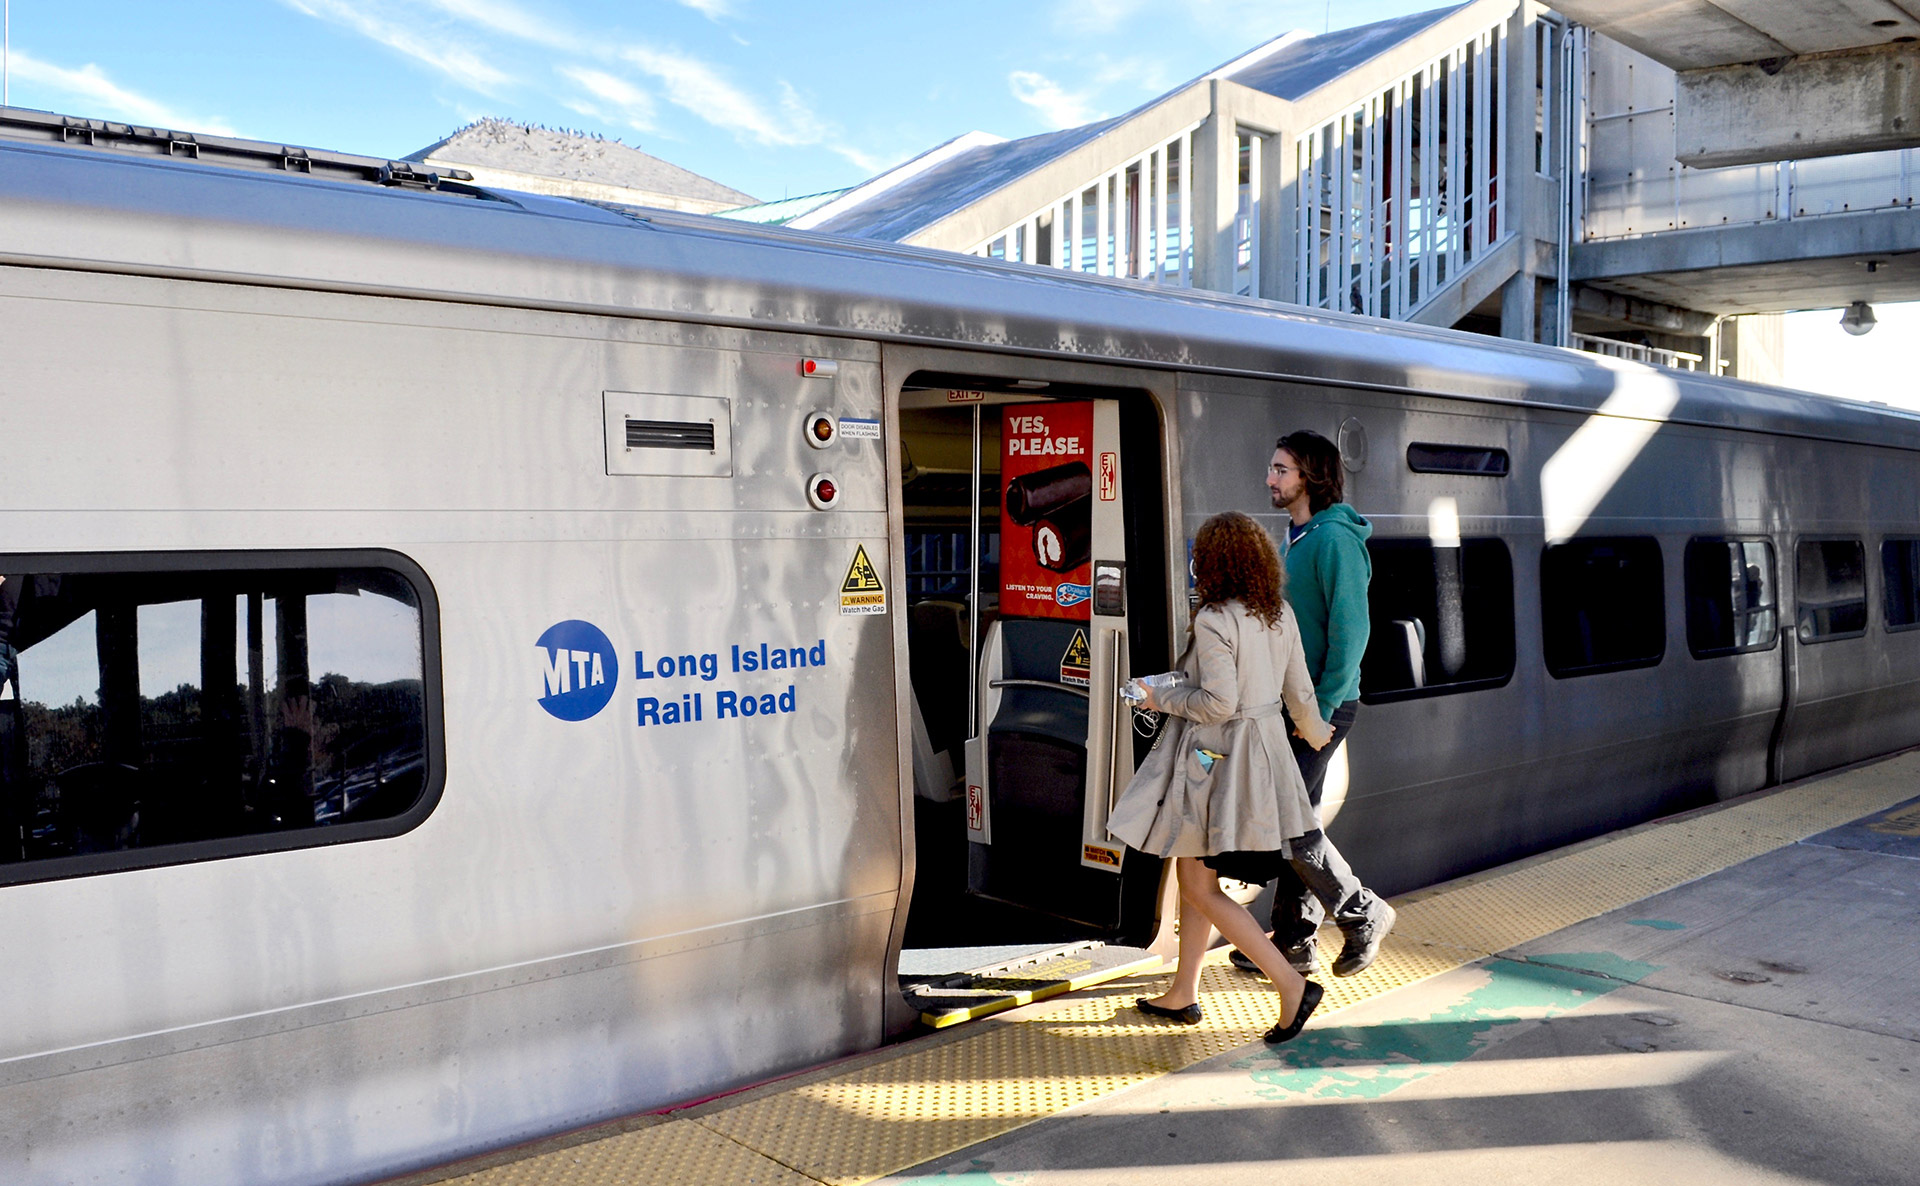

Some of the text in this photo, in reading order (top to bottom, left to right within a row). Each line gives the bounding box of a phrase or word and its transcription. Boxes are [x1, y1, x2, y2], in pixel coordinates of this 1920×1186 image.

[1009, 416, 1049, 436] YES,
[1009, 437, 1084, 456] PLEASE.
[1006, 584, 1026, 592] LISTEN
[1036, 585, 1053, 593] YOUR
[1026, 593, 1054, 601] CRAVING.
[842, 606, 860, 614] Watch
[872, 605, 884, 613] Gap
[851, 596, 882, 604] WARNING
[635, 639, 826, 681] Long Island
[536, 646, 605, 699] MTA
[637, 685, 796, 727] Rail Road
